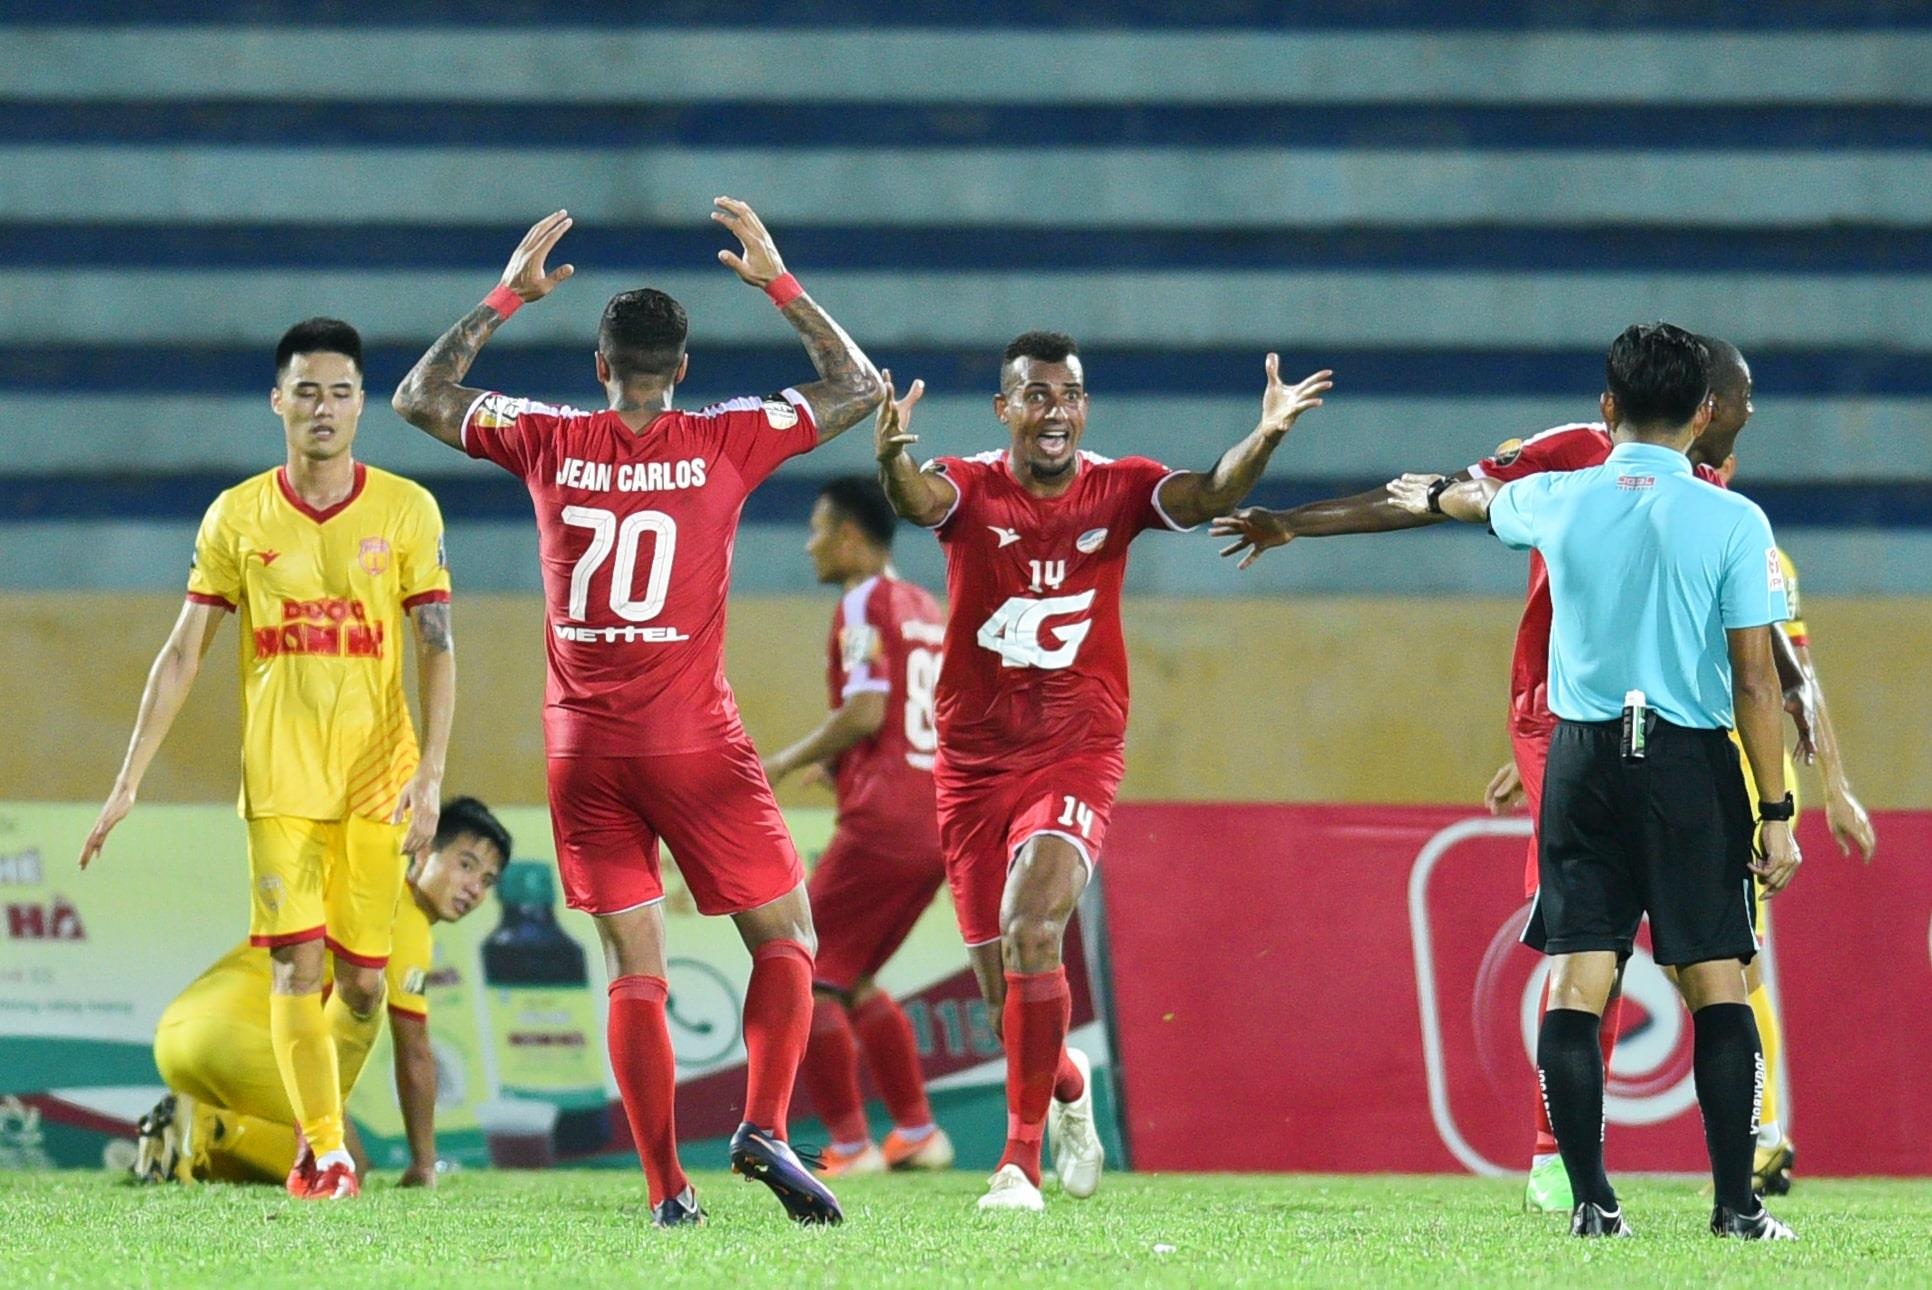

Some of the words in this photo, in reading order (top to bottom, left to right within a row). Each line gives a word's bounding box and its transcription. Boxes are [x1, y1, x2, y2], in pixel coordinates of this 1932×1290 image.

[555, 458, 612, 492] JEAN
[617, 457, 706, 492] CARLOS
[561, 505, 677, 622] 70
[1028, 559, 1065, 593] 14
[977, 588, 1097, 670] 4G
[1057, 796, 1095, 836] 14
